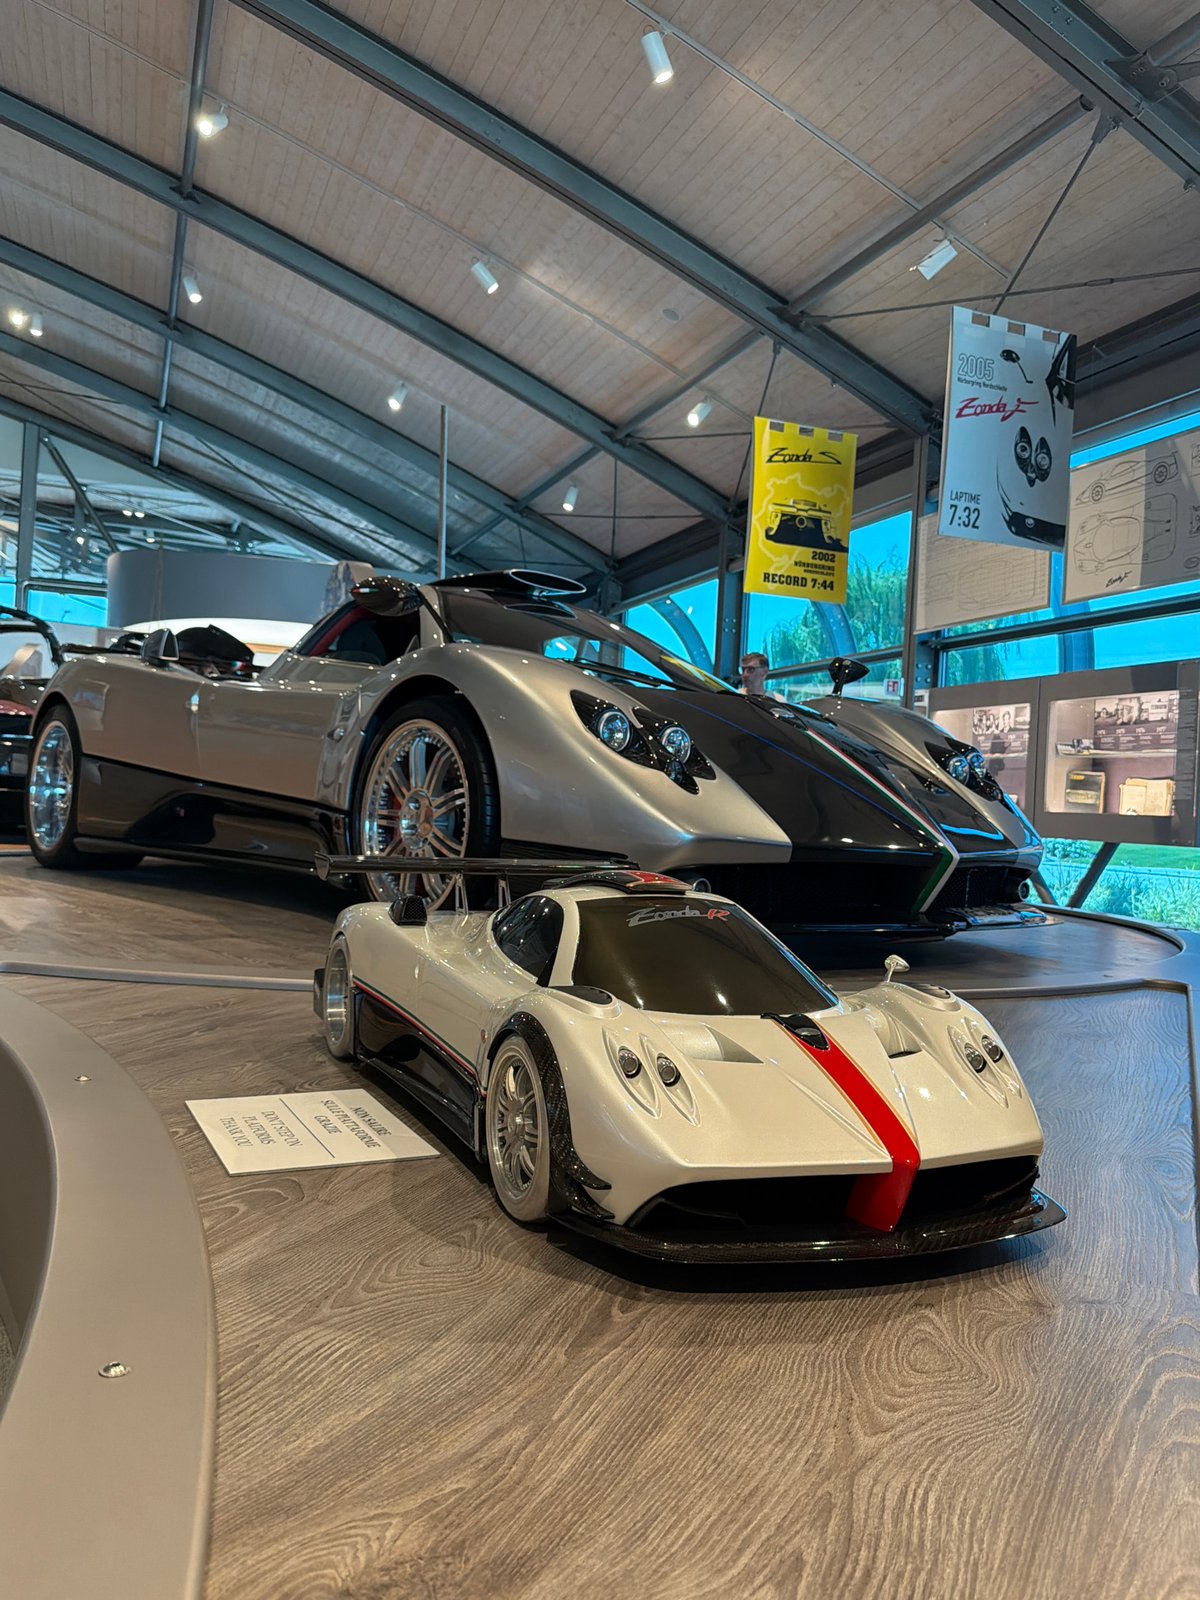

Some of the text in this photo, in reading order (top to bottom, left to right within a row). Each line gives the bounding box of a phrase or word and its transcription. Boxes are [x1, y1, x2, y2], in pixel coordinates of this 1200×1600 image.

[958, 353, 995, 381] 2005
[955, 394, 1007, 419] Zonda
[766, 447, 842, 465] Zonda S
[950, 490, 981, 505] LAPTIME
[949, 503, 981, 530] 7:32
[811, 550, 836, 563] 2002
[763, 572, 808, 588] RECORD
[810, 578, 835, 592] 7:44
[626, 904, 730, 927] Zonda R
[219, 1116, 254, 1147] THANK YOU
[242, 1115, 276, 1145] PLATFORMS
[272, 1124, 295, 1138] STEP
[313, 1114, 342, 1134] GRAZIE
[320, 1099, 381, 1148] SULLE PIATTAFORME
[349, 1106, 392, 1136] NON SALIRE
[283, 1137, 303, 1147] ON
